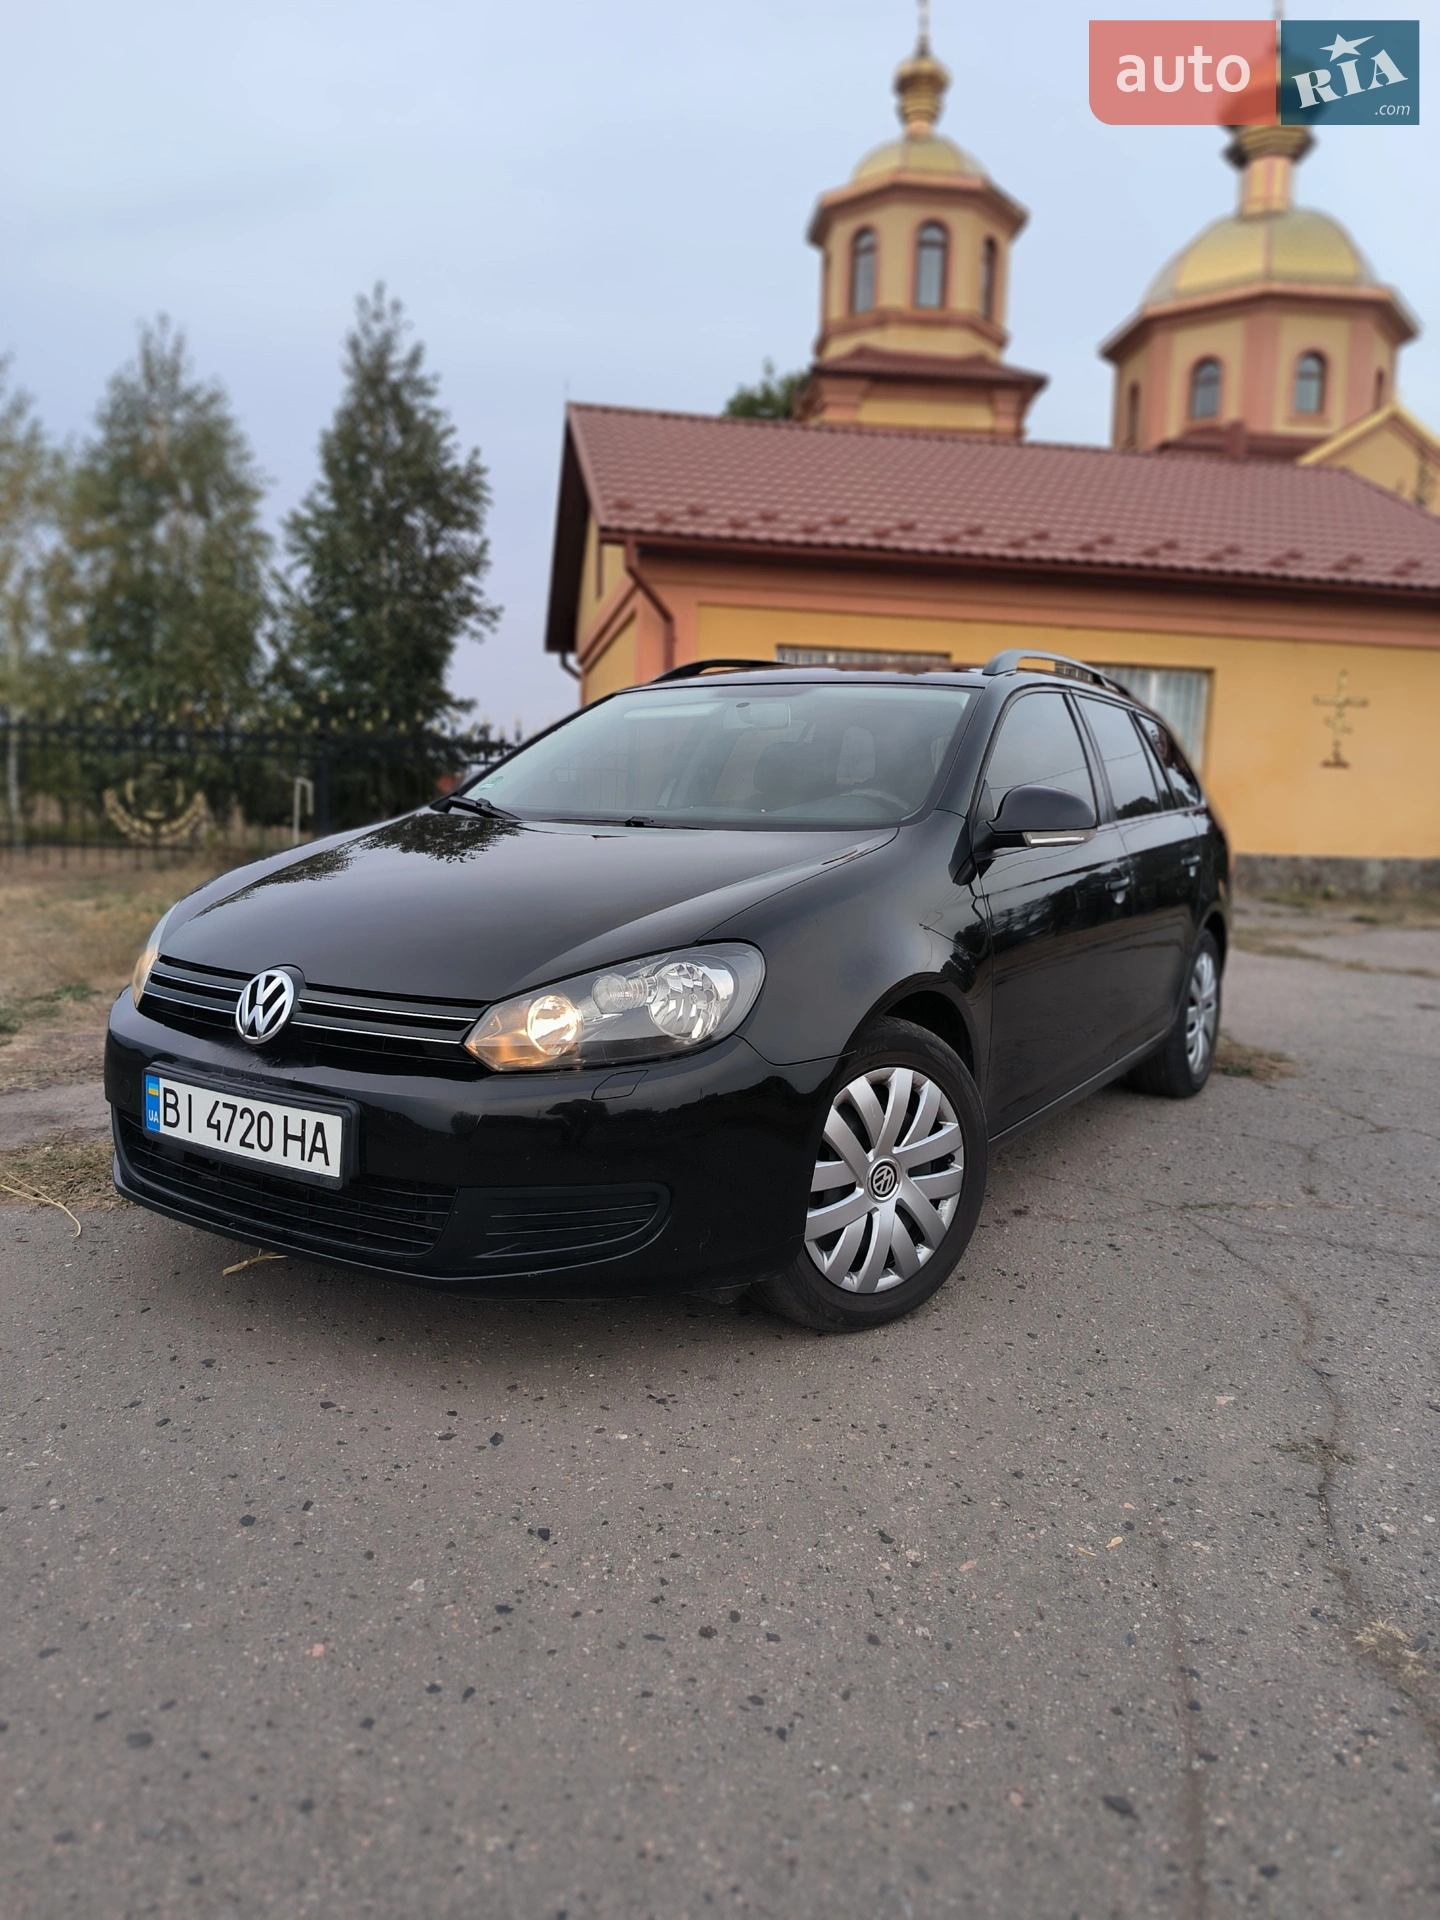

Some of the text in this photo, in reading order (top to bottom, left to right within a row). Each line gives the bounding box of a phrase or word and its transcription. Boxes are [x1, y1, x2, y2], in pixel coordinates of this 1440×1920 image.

[148, 1108, 159, 1124] UA
[163, 1086, 330, 1167] BI 4720 HA
